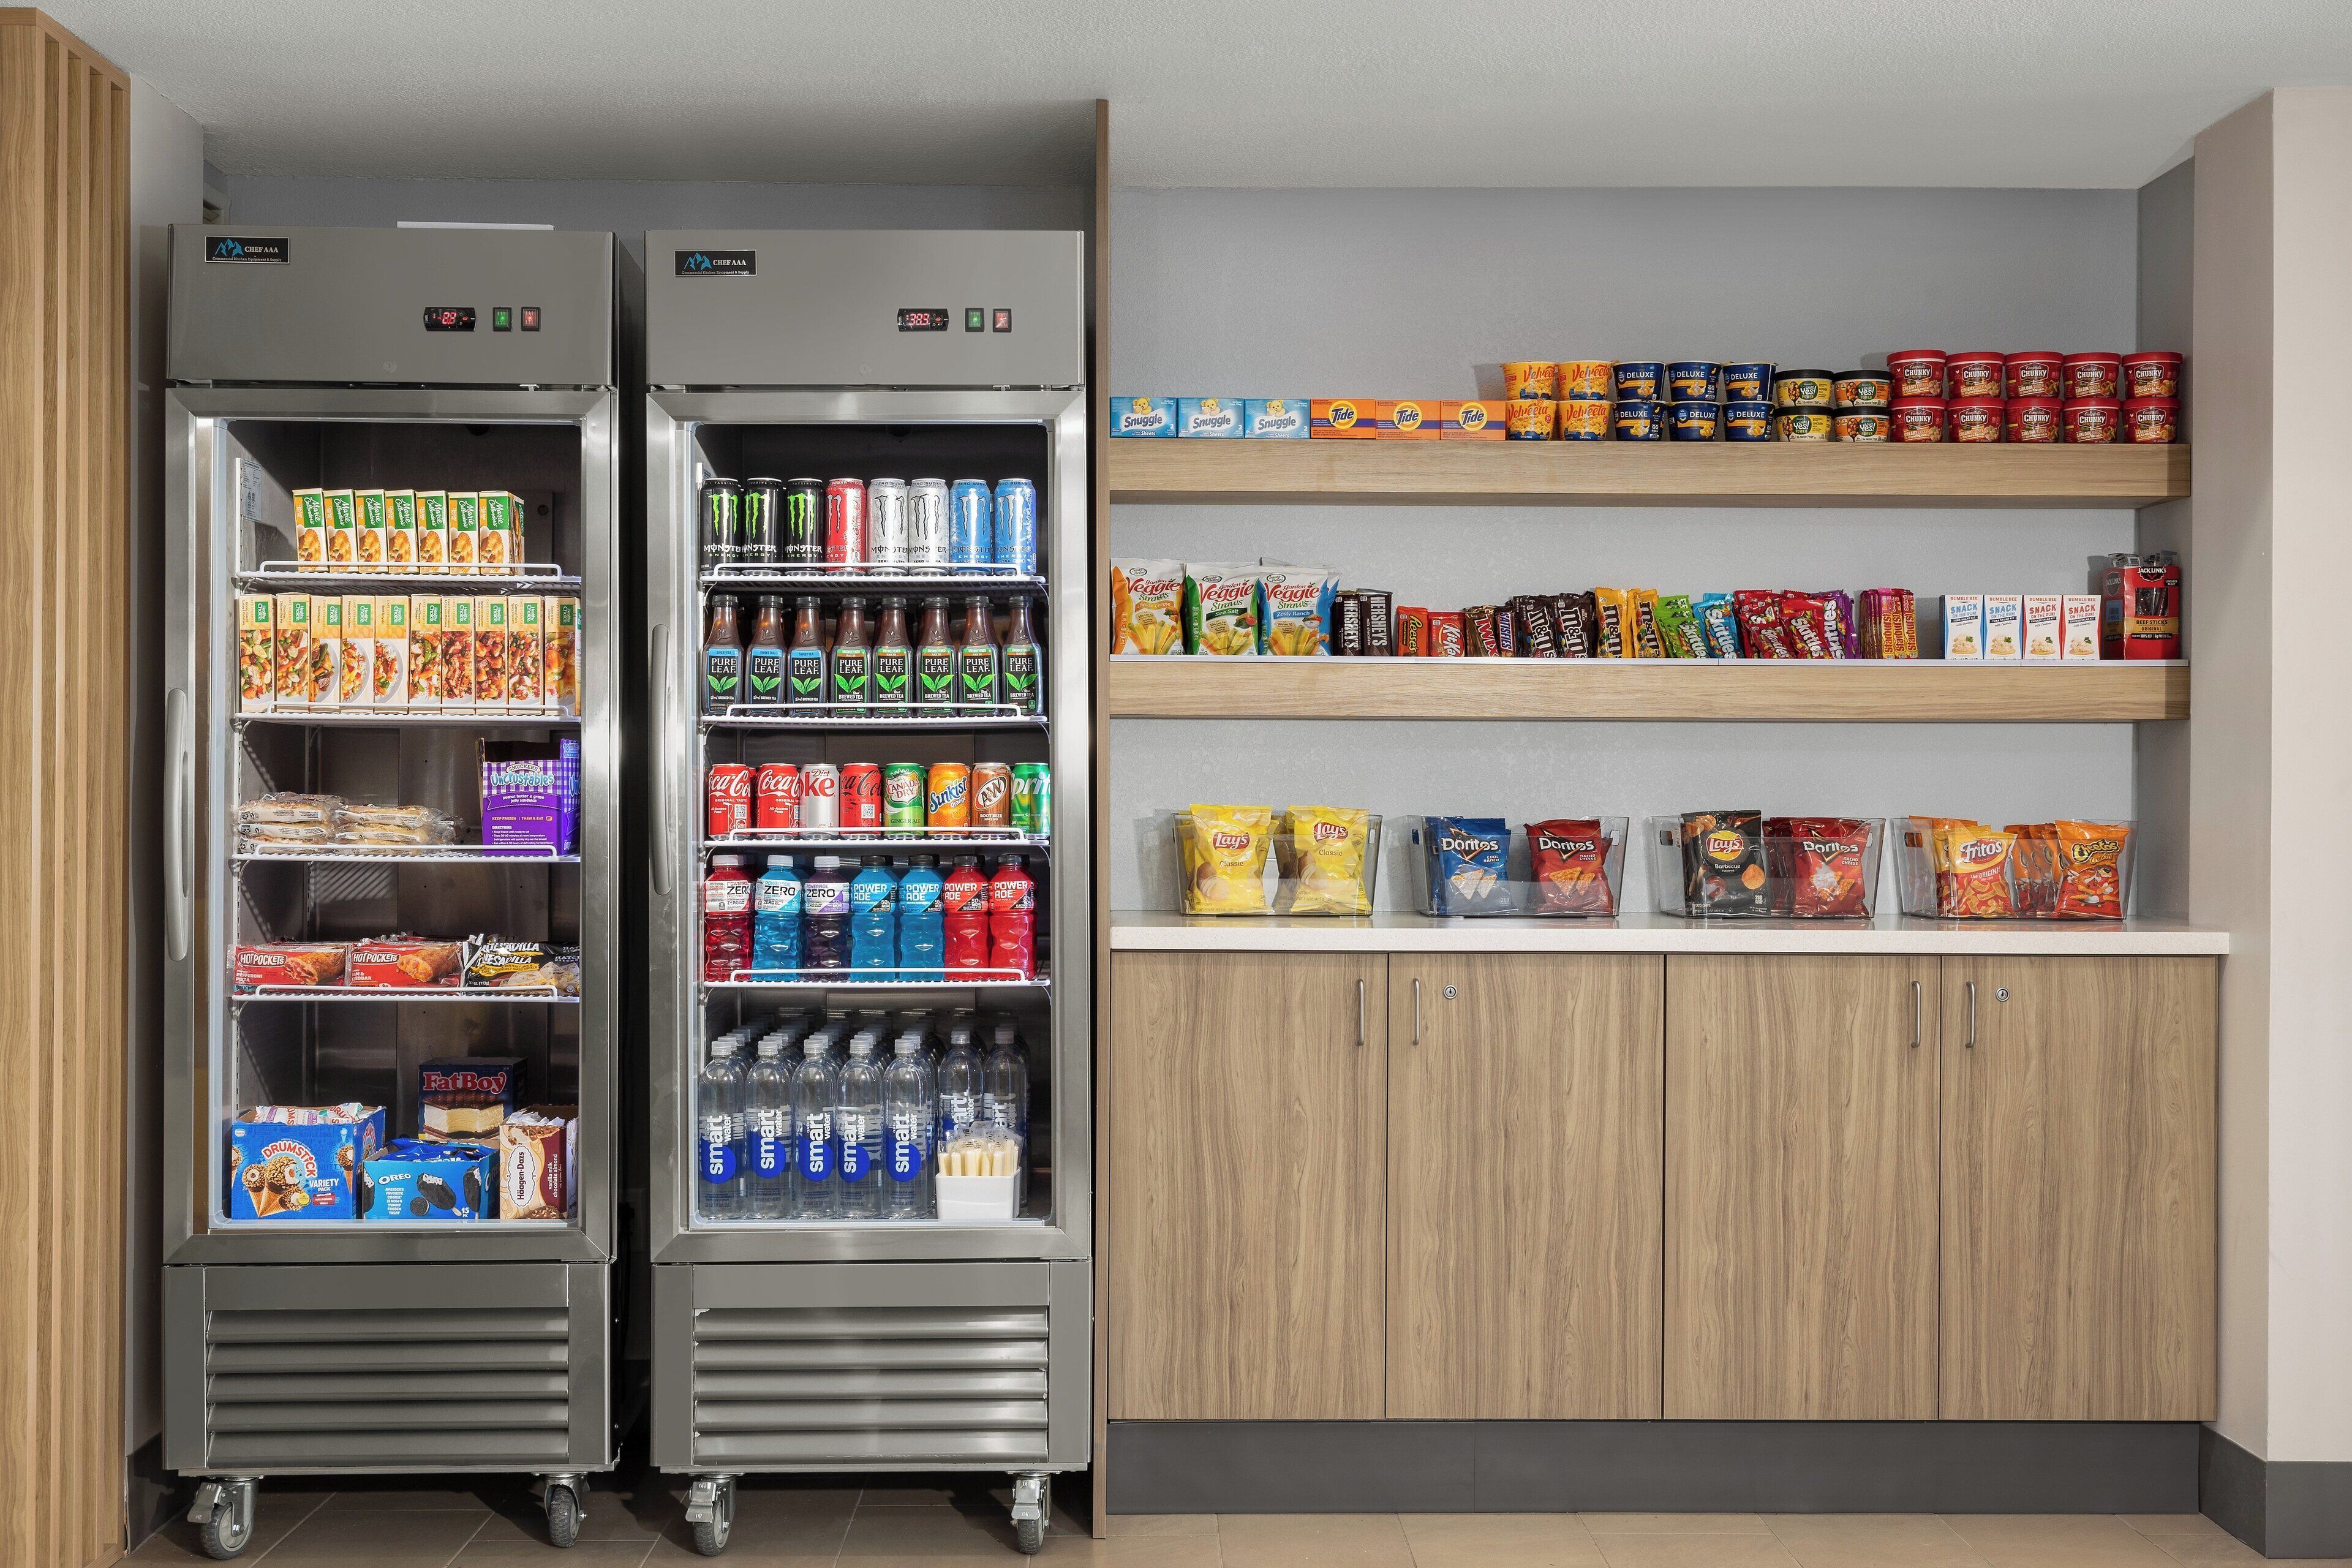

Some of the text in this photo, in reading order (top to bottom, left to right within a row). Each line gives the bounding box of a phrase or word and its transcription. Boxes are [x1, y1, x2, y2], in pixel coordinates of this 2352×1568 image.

[2077, 370, 2103, 379] CHUNKY
[1800, 386, 1817, 396] Yes!
[1125, 413, 1163, 428] Snuggle
[1332, 408, 1354, 423] Tide
[1461, 409, 1485, 426] Tide
[1508, 404, 1548, 422] Velveeta
[1566, 404, 1606, 422] Velveeta
[1860, 421, 1875, 432] Yes!
[310, 497, 320, 522] Marie
[465, 500, 475, 526] Marie
[494, 499, 503, 525] Marie
[704, 543, 741, 552] MONSTER
[1126, 577, 1182, 595] Veggie
[1264, 582, 1321, 602] Veggie
[1950, 603, 1978, 614] SNACK
[2029, 604, 2056, 614] SNACK
[1371, 597, 1387, 646] HERSHEY'S
[1475, 617, 1499, 657] TWIX
[1705, 609, 1736, 658] Skittles
[1791, 617, 1823, 657] Skittles
[1905, 613, 1917, 651] Starburst
[491, 772, 555, 787] Uncrustables
[887, 778, 920, 795] CANADA
[895, 787, 914, 799] DRY
[929, 776, 968, 814] Sunkist
[981, 778, 1002, 808] A&W
[950, 796, 967, 808] Orange
[1316, 822, 1348, 840] Lay's
[1215, 833, 1249, 850] Lay's
[1441, 838, 1499, 851] Doritos
[1709, 839, 1744, 853] Lay's
[1803, 842, 1858, 853] Doritos
[1960, 841, 2002, 863] Fritos
[2073, 840, 2119, 861] Cheetos
[2090, 854, 2113, 864] Crunchy
[764, 886, 796, 895] ZERO
[807, 889, 835, 898] ZERO
[907, 884, 940, 893] POWER
[995, 881, 1028, 890] POWER
[995, 890, 1013, 899] ADE
[240, 953, 284, 965] HOT POCKETS
[423, 1072, 507, 1094] FatBoy
[709, 1115, 723, 1175] smart
[843, 1114, 856, 1174] smart
[895, 1114, 910, 1173] smart
[262, 1142, 317, 1178] DRUMSTICK
[309, 1178, 339, 1188] VARIETY
[379, 1174, 412, 1185] OREO
